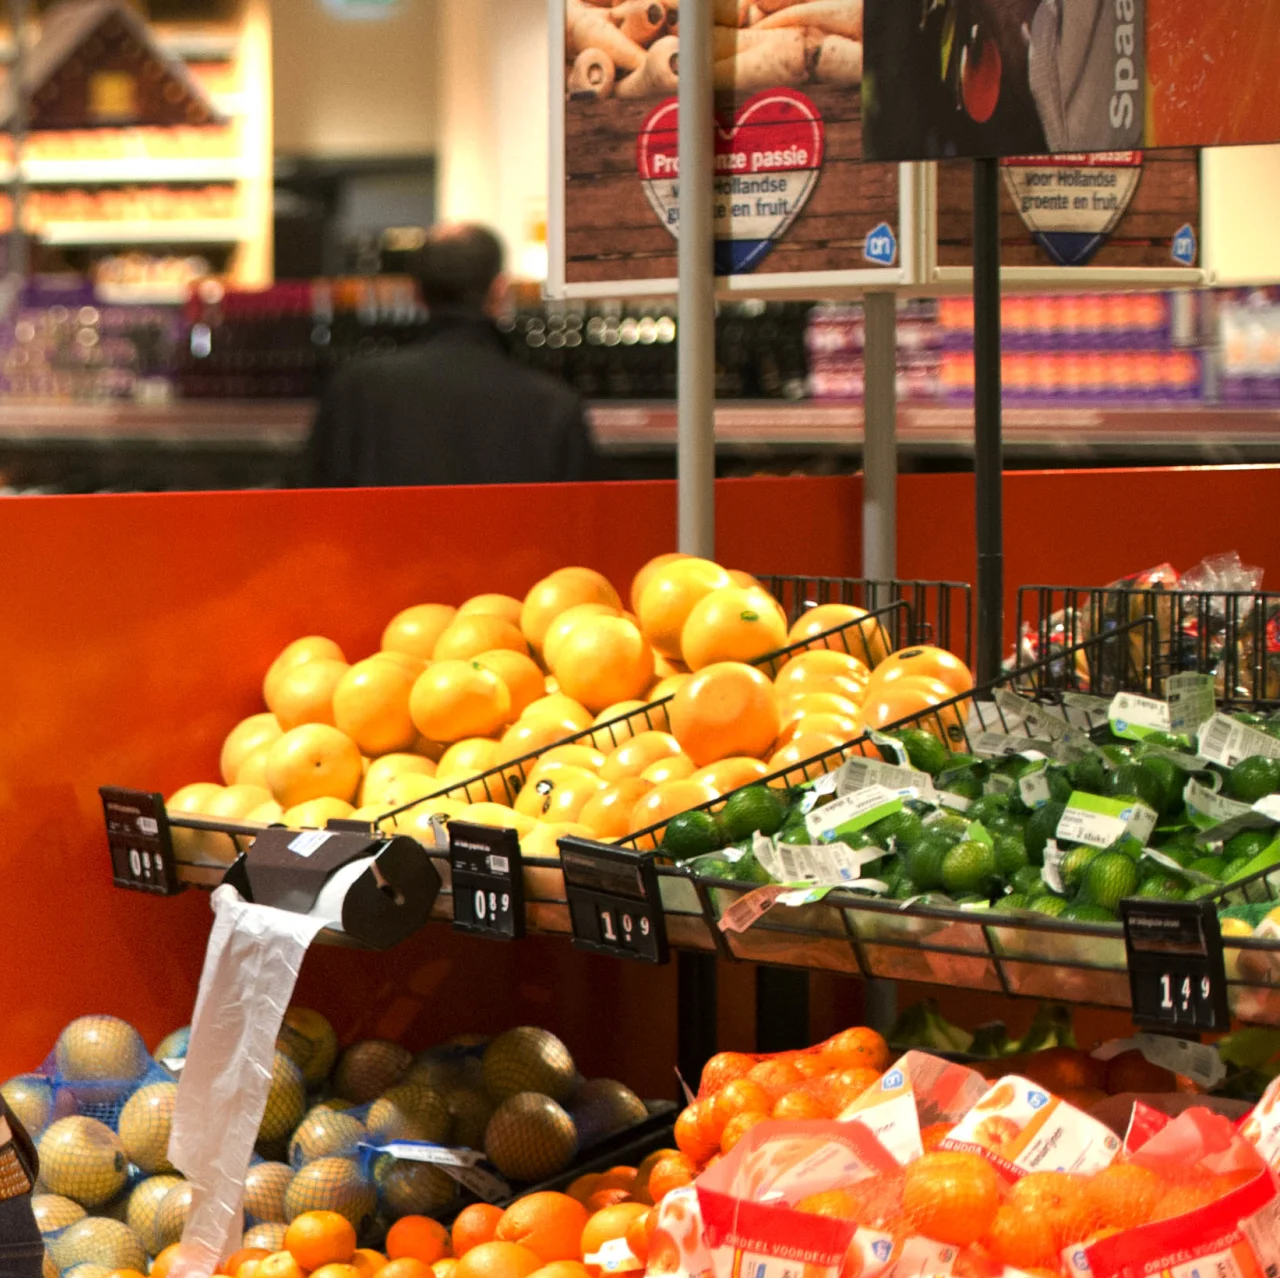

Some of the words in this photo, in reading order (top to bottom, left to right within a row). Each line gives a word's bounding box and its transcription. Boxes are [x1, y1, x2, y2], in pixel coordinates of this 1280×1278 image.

[751, 144, 808, 172] passie
[1024, 173, 1053, 187] voor
[1057, 168, 1117, 188] Hollandse
[731, 203, 751, 216] en
[1020, 193, 1069, 213] groente
[1073, 196, 1089, 210] en
